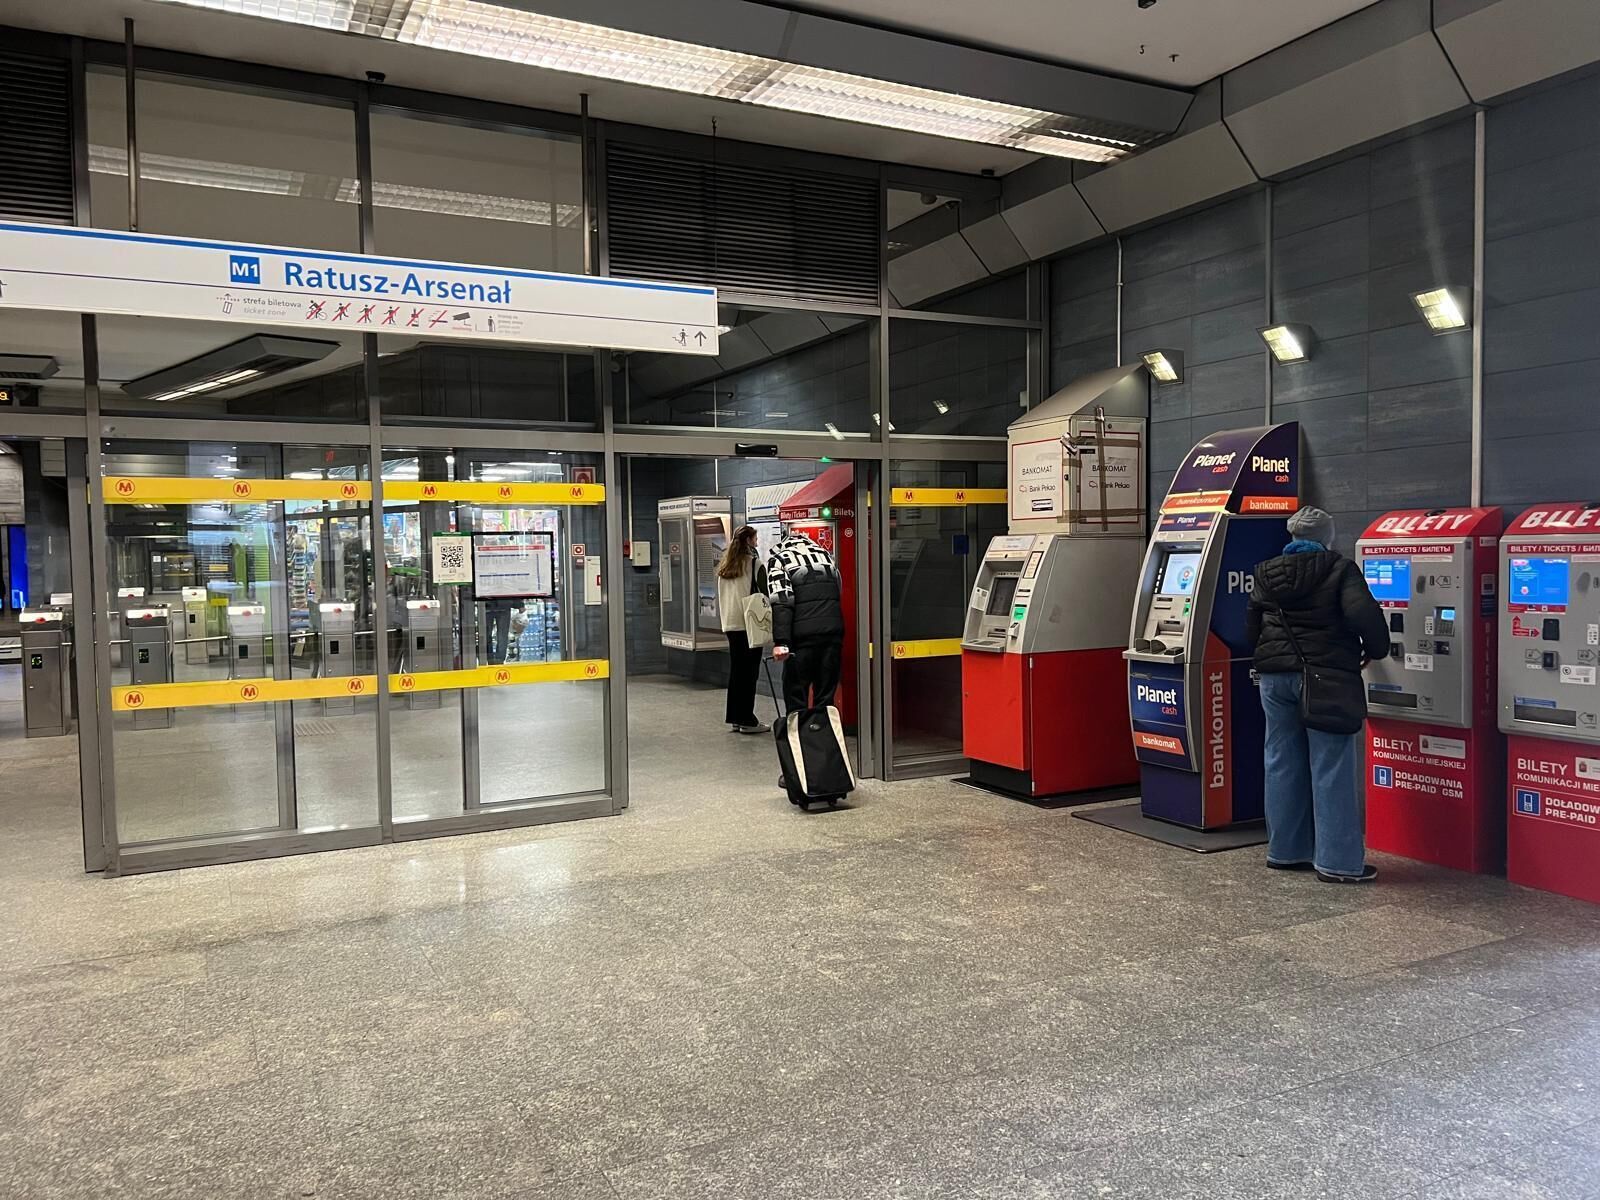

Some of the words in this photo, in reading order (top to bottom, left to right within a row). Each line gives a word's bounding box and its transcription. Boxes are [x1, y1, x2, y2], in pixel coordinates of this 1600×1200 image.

[232, 262, 259, 277] M1
[285, 262, 512, 304] Ratusz-Arsenał
[243, 297, 266, 306] strefa
[268, 298, 302, 308] biletowa
[1192, 451, 1237, 468] Planet
[1252, 456, 1290, 473] Planet
[1022, 465, 1053, 476] BANKOMAT
[1212, 465, 1229, 473] cash
[1114, 481, 1131, 489] Pekao
[1274, 475, 1289, 483] cash
[1029, 485, 1041, 493] Bank
[1041, 484, 1056, 492] Pekao
[1176, 496, 1221, 505] bankomat
[1250, 500, 1289, 510] bankomat
[834, 508, 855, 517] Bilety
[1520, 510, 1600, 528] BILE
[1376, 514, 1472, 532] BILETY
[1137, 685, 1177, 706] Planet
[1161, 706, 1178, 716] cash
[1209, 671, 1223, 789] bankomat
[1142, 735, 1177, 750] bankomat
[1373, 737, 1413, 752] BILETY
[1373, 750, 1424, 764] KOMUNIKACJI
[1425, 757, 1466, 770] MIEJSKIEJ
[1517, 758, 1568, 776] BILETY
[1395, 770, 1463, 789] DOŁADOWANIA
[1517, 772, 1580, 789] KOMUNIKACJI
[1395, 780, 1437, 794] PRE-PAID
[1442, 788, 1463, 798] GSM
[1545, 797, 1600, 814] DOŁADOW
[1545, 808, 1596, 824] PRE-PAID
